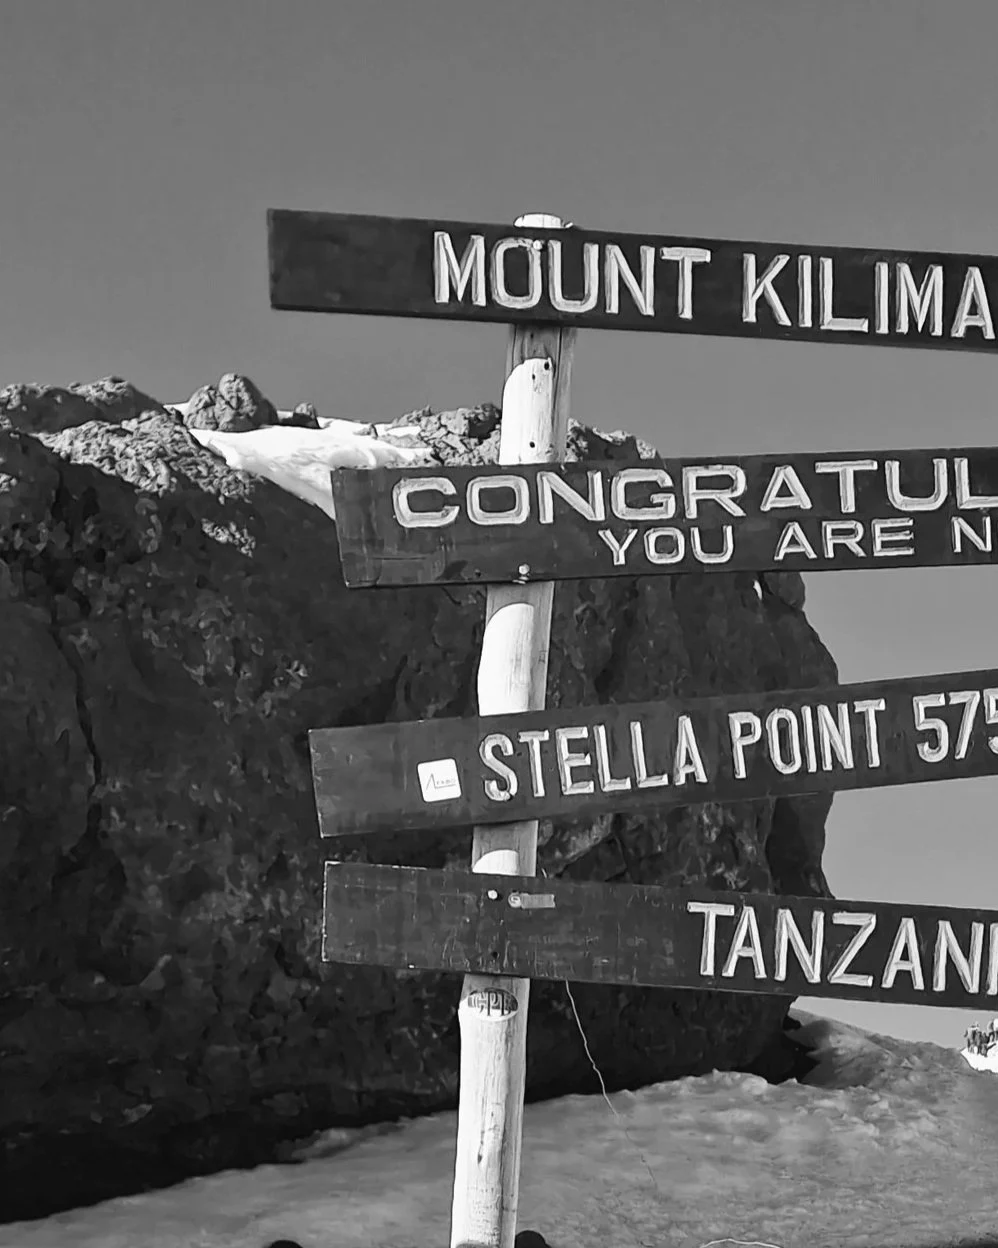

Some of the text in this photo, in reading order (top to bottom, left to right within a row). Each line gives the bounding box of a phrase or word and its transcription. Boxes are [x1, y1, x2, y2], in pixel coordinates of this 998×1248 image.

[432, 231, 712, 320] MOUNT
[597, 524, 734, 566] YOU
[773, 517, 915, 561] ARE
[478, 714, 708, 802] STELLA
[727, 698, 886, 779] POINT
